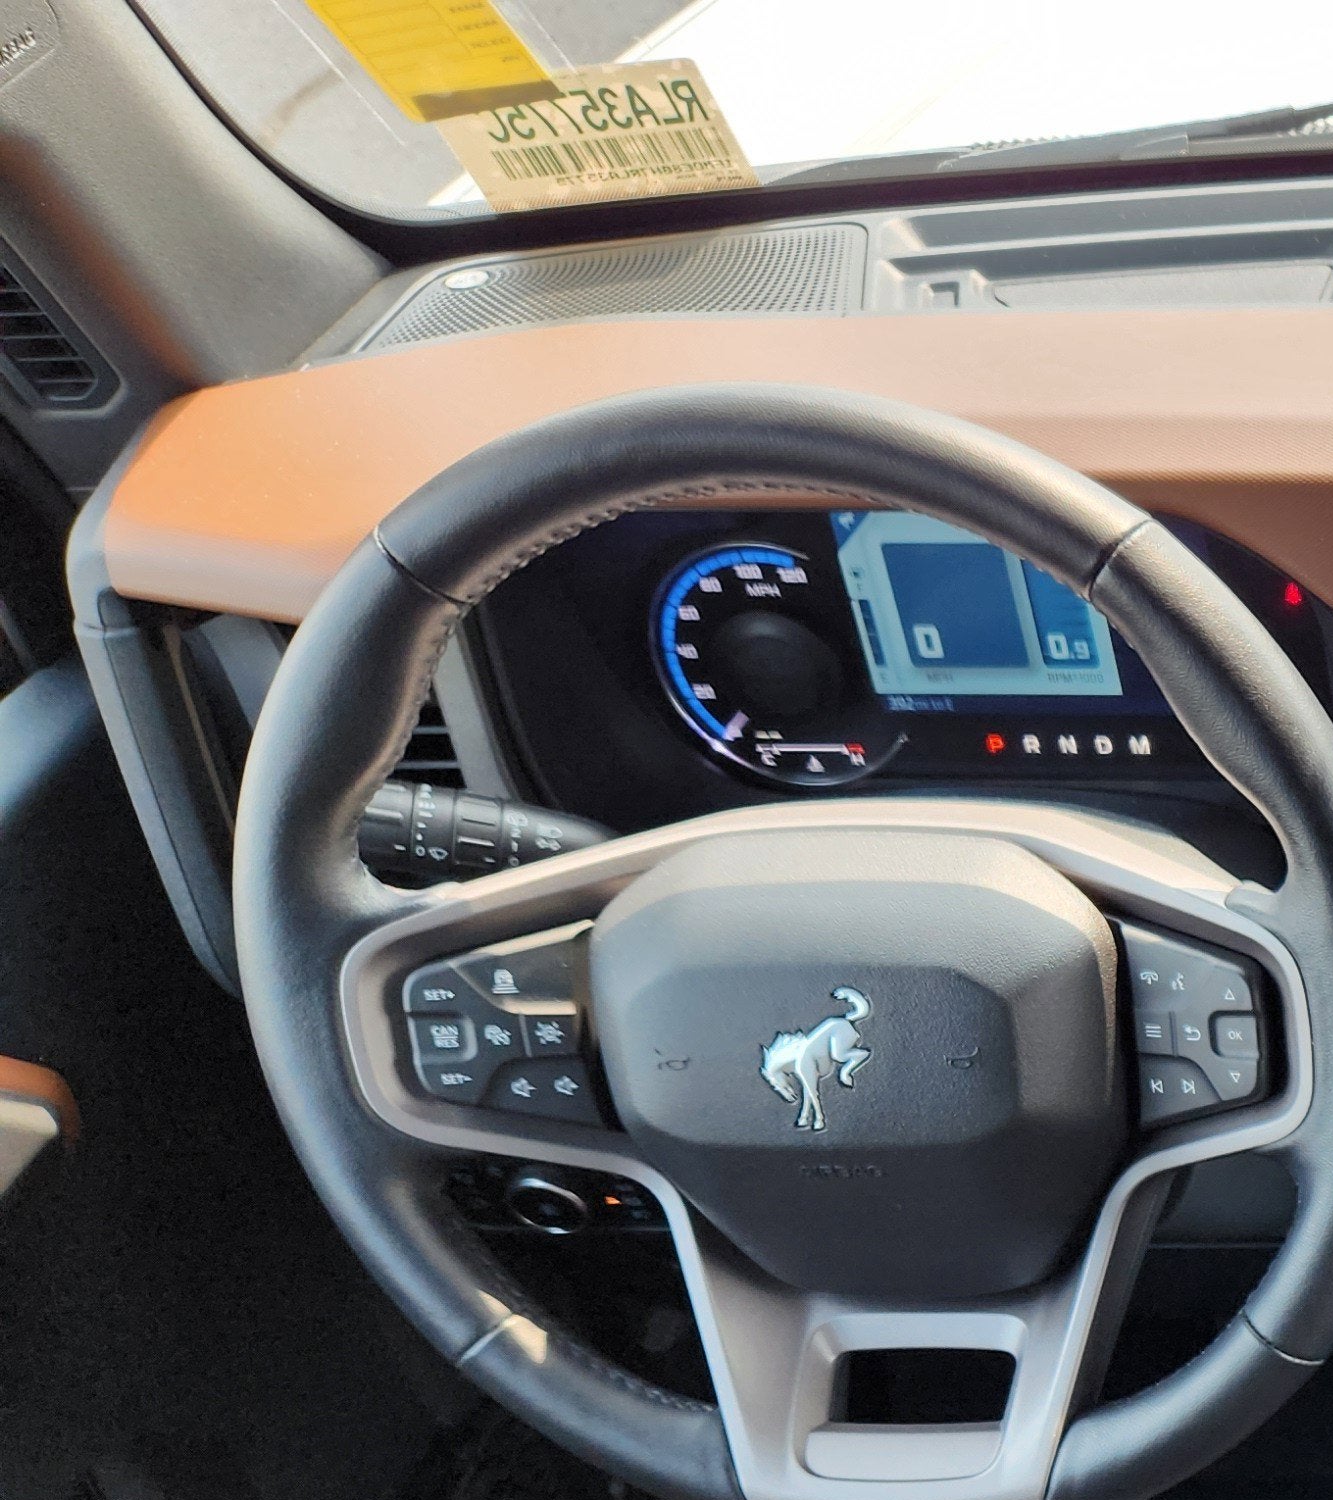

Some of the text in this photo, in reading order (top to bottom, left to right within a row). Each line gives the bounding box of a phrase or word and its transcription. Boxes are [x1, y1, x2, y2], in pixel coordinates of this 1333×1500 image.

[745, 583, 781, 598] MPH
[913, 623, 944, 659] 0
[1046, 632, 1090, 660] 0.9
[986, 733, 1151, 755] P R N D M
[430, 1024, 459, 1036] CAN
[1227, 1030, 1243, 1041] OK
